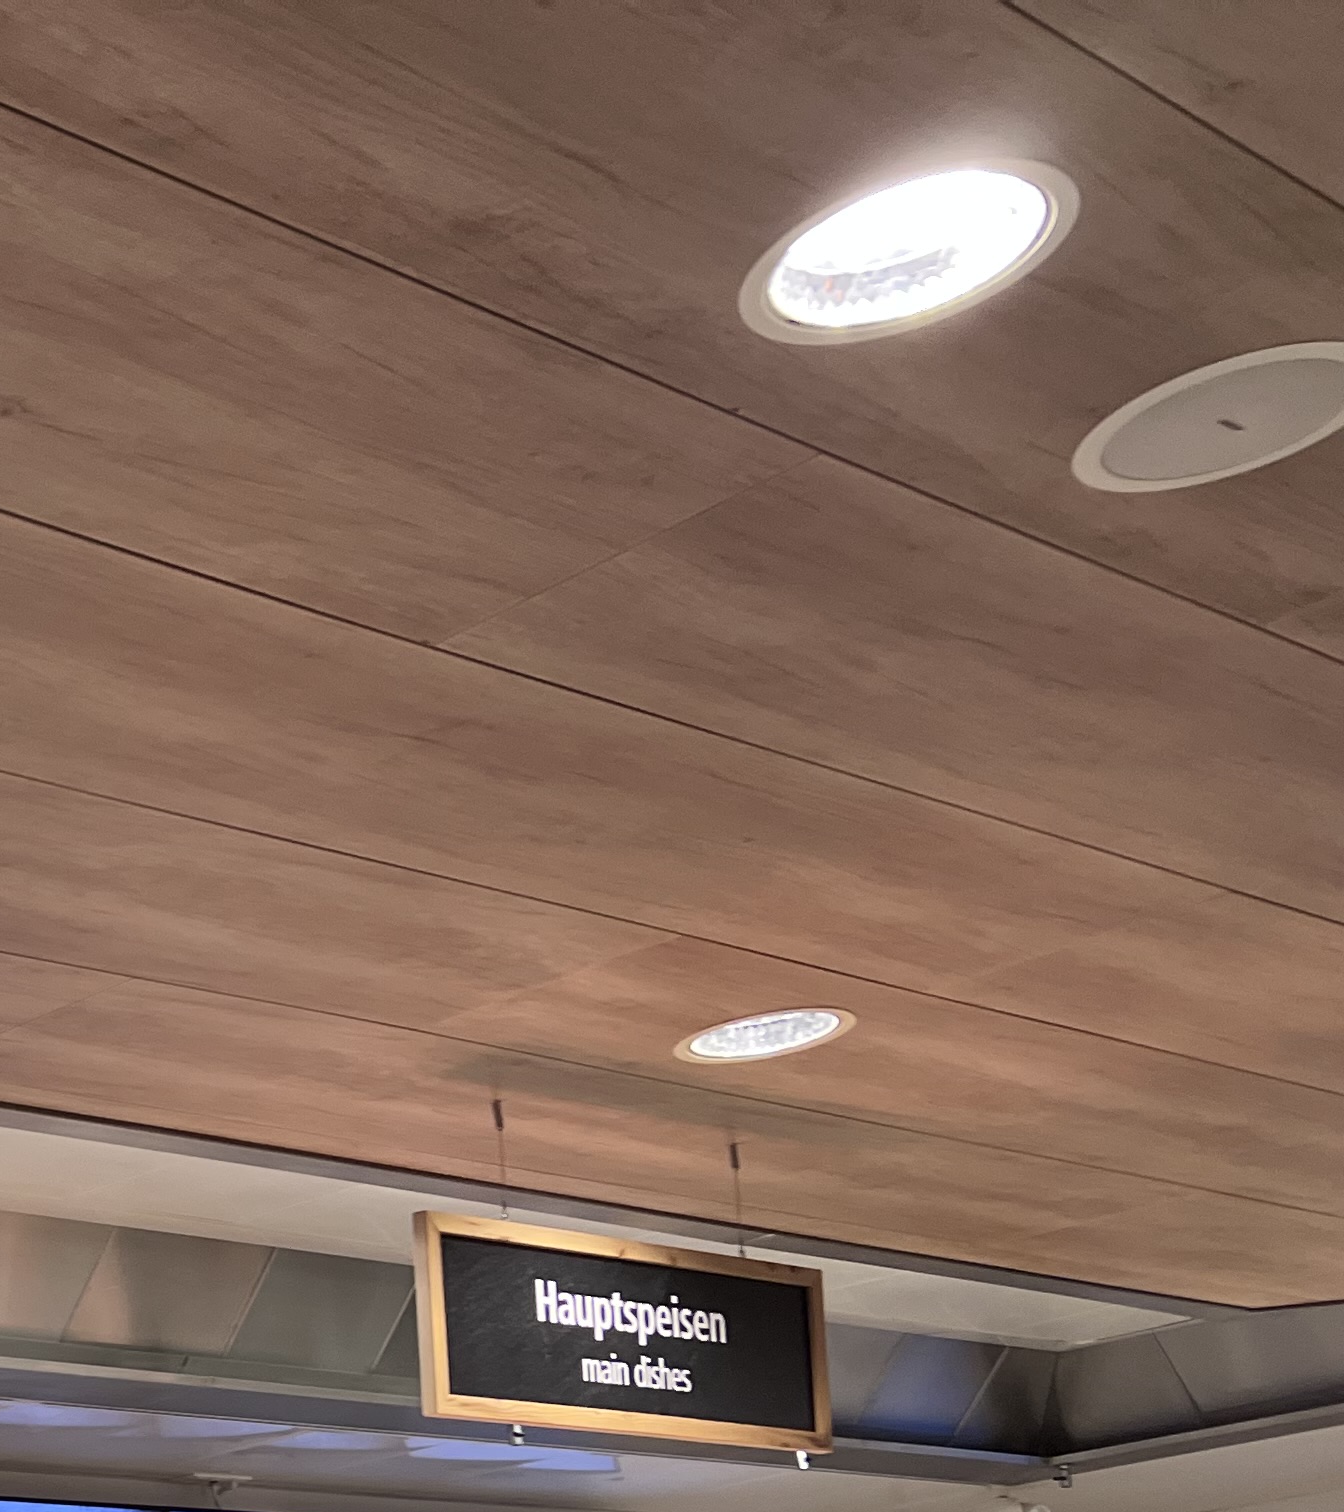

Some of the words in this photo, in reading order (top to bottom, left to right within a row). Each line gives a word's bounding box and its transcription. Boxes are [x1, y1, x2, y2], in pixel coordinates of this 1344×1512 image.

[534, 1278, 727, 1346] Hauptspeisen
[581, 1353, 630, 1387] main
[633, 1355, 693, 1393] dishes
